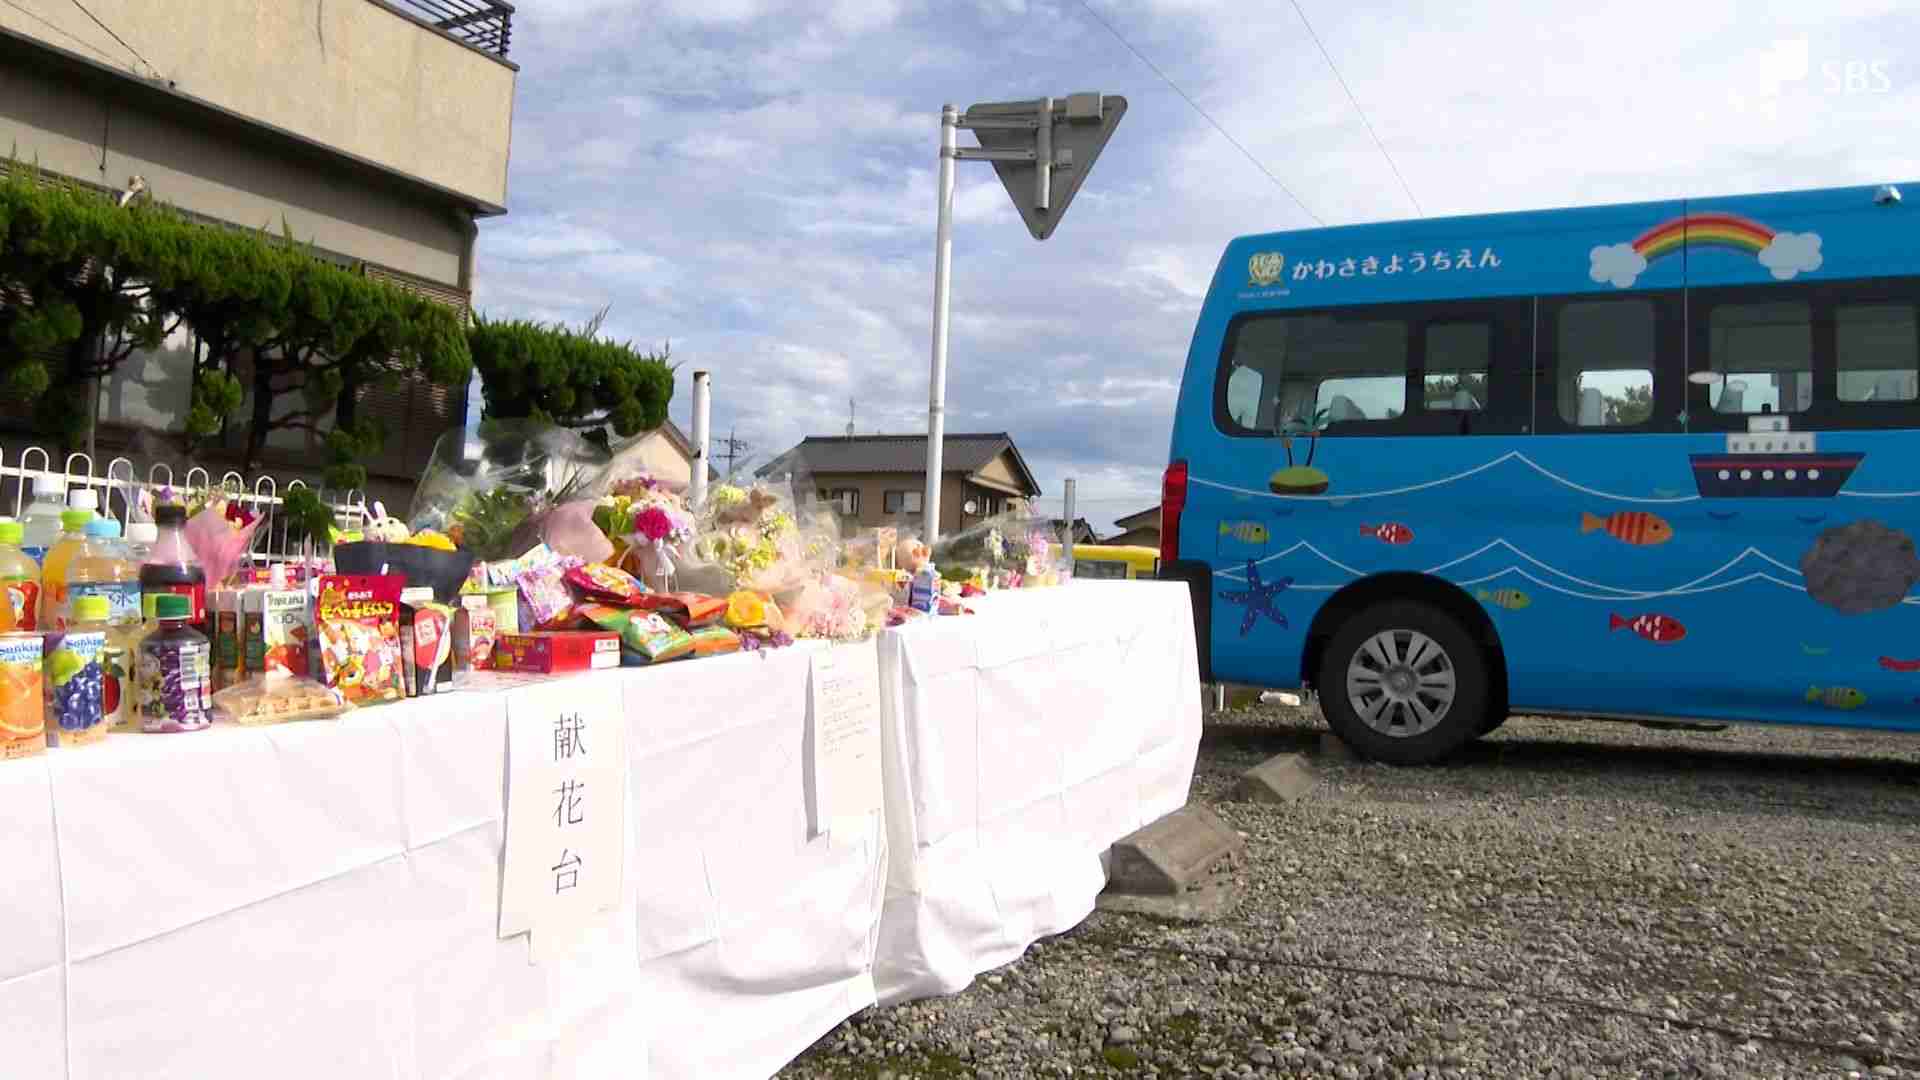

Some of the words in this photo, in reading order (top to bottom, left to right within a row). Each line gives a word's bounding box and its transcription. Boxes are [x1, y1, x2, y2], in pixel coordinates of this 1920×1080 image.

[1292, 248, 1502, 280] かわさきようちえん
[552, 711, 587, 895] 献花台
